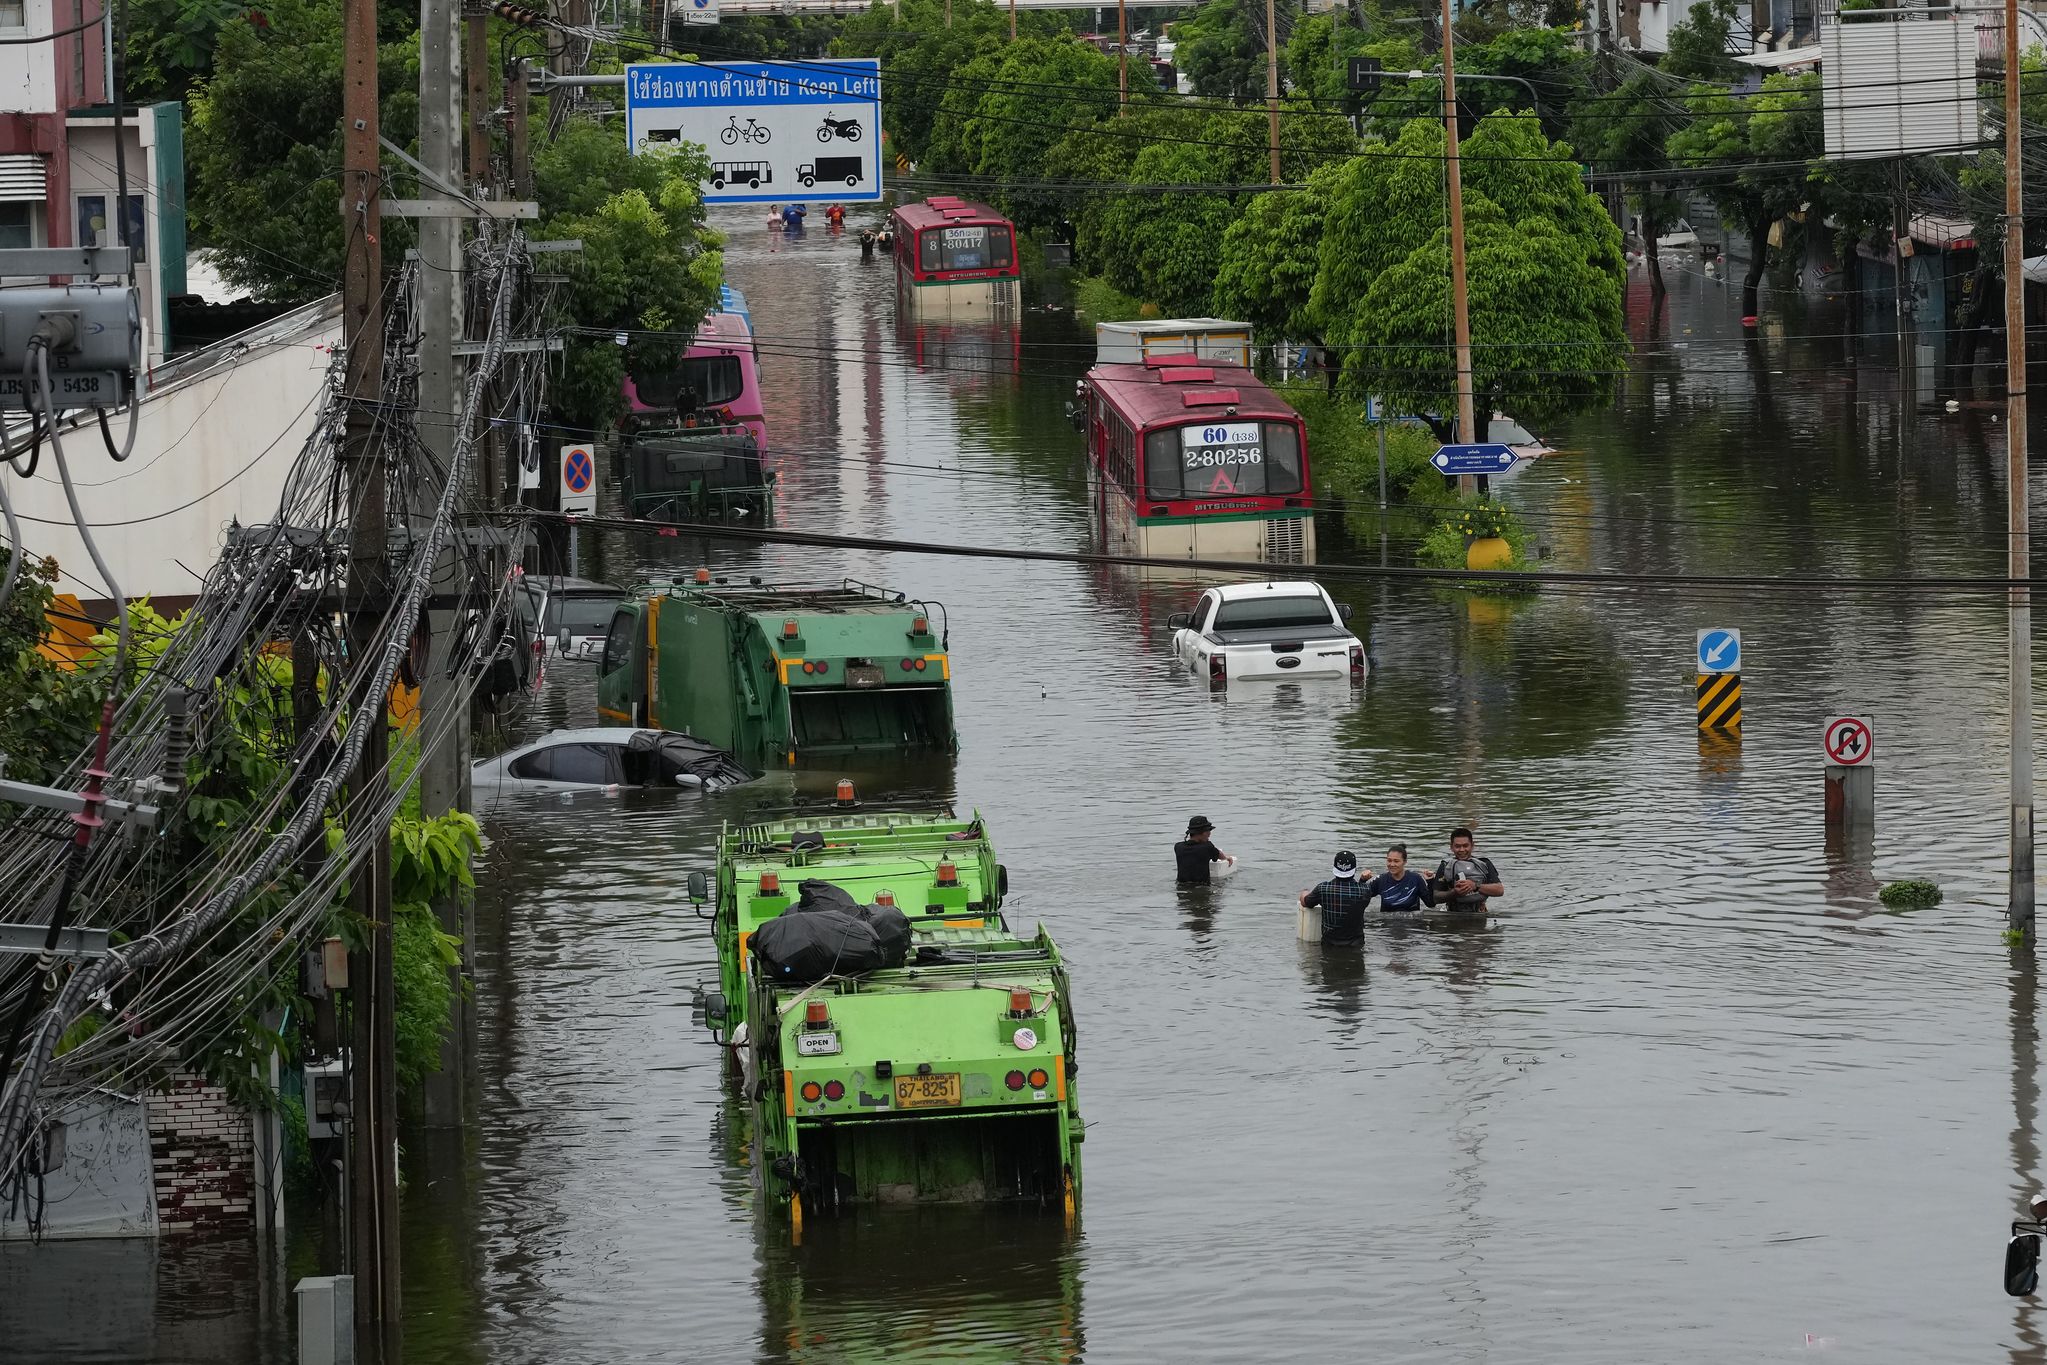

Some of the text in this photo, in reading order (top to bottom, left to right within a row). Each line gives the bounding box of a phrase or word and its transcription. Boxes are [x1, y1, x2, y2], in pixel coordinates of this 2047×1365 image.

[631, 70, 875, 99] ใช้ช่องทางด้านซ้าย Keep Left
[56, 356, 69, 369] B
[63, 377, 99, 393] 5438
[1203, 427, 1227, 443] 60
[1186, 447, 1261, 467] 2-80256
[1194, 501, 1259, 511] MITSUBISHI
[806, 1039, 829, 1047] OPEN
[898, 1080, 954, 1099] 67-8251
